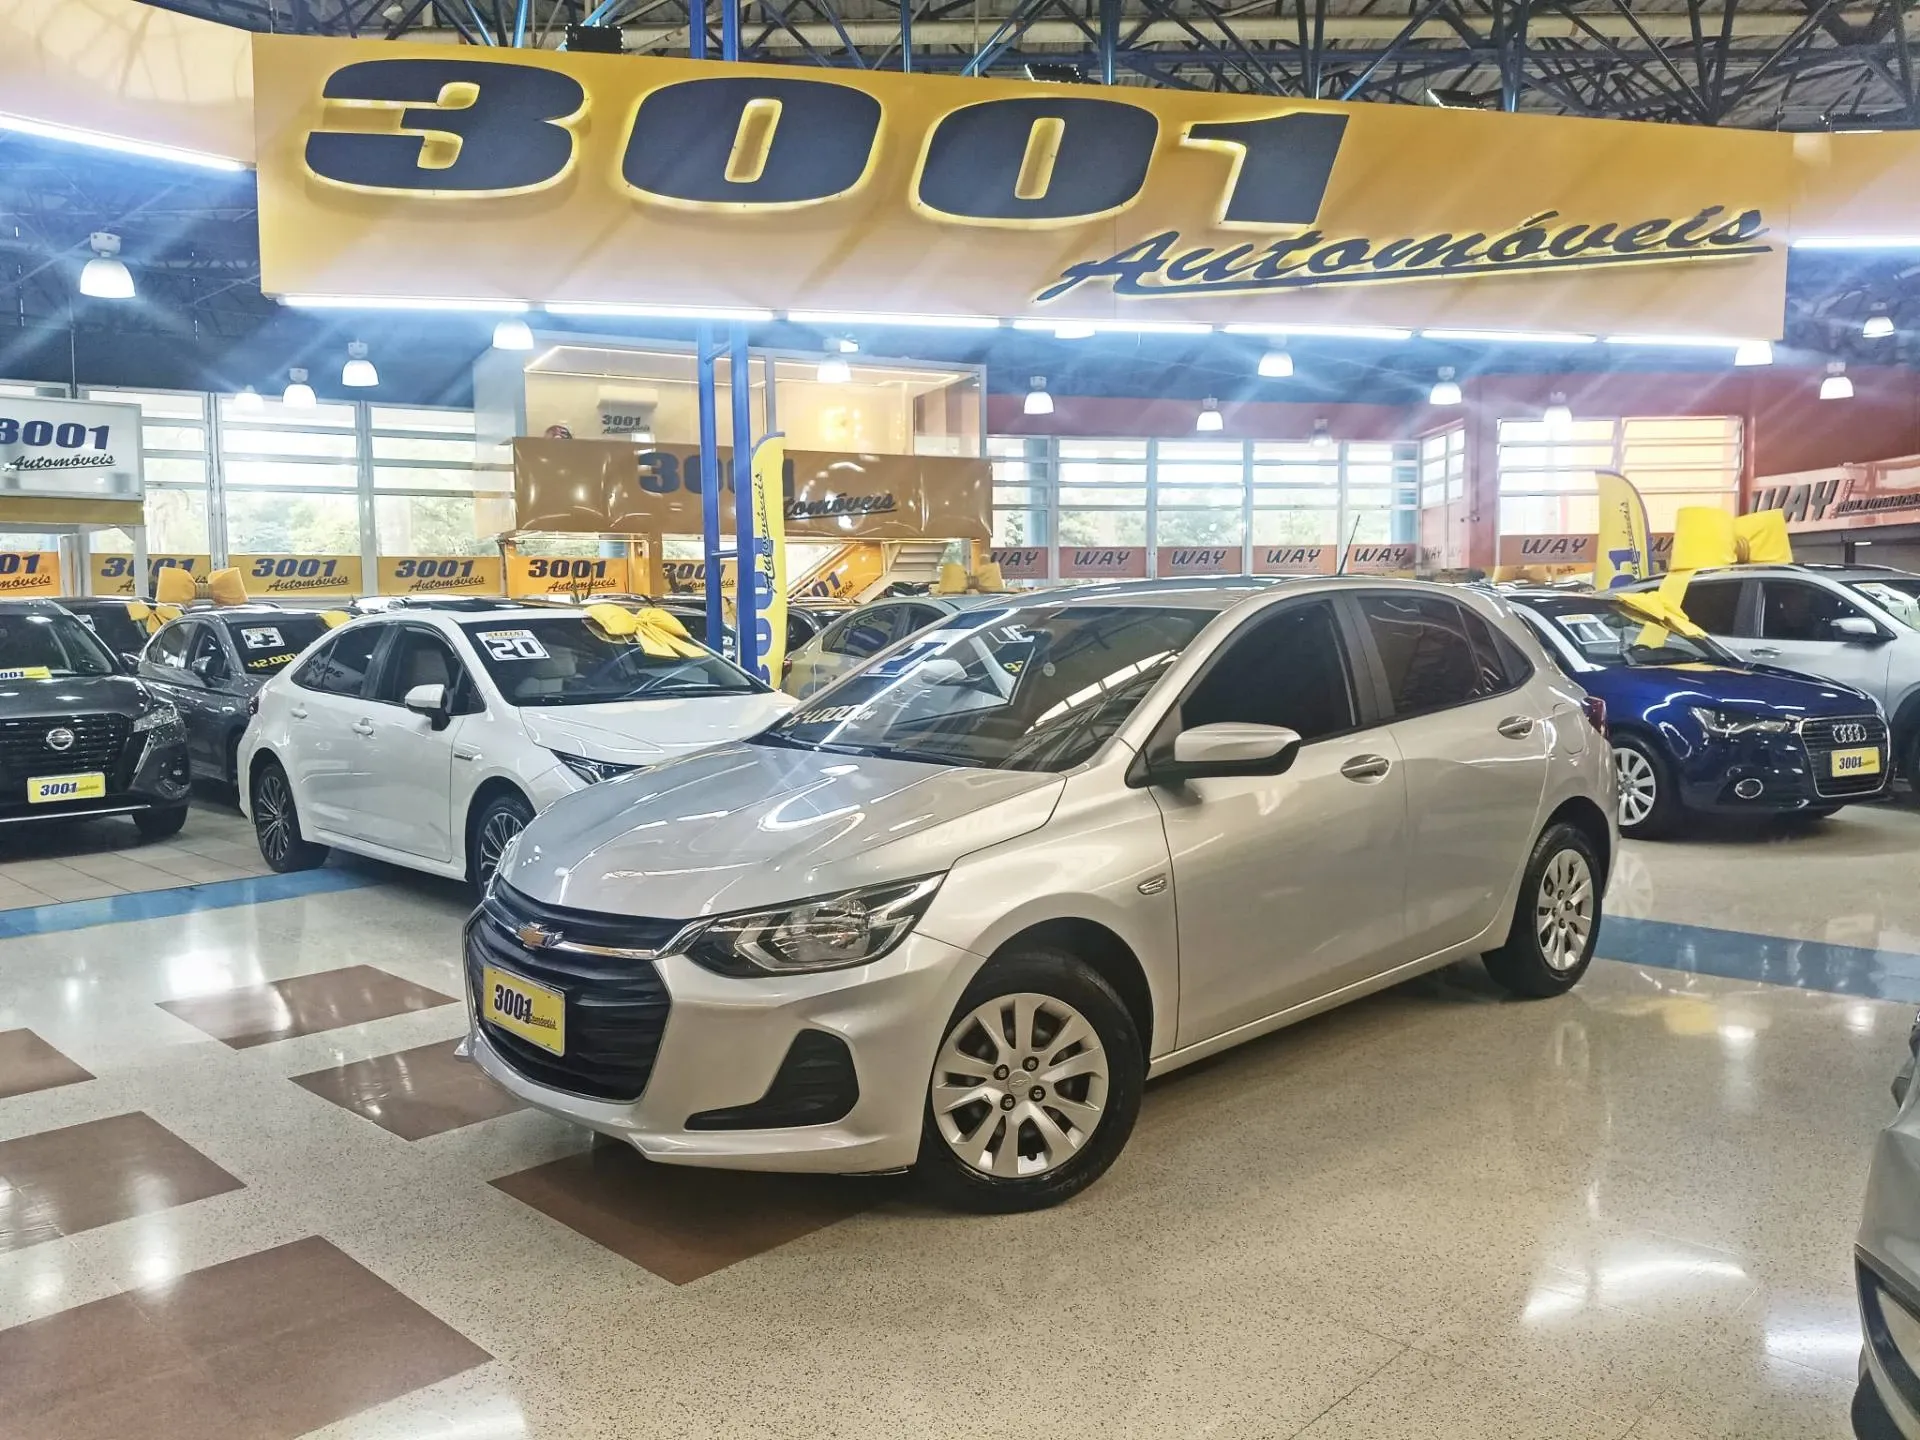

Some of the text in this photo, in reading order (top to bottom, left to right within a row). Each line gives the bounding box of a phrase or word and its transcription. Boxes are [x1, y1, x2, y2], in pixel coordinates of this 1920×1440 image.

[304, 57, 1348, 230] 3001
[1037, 205, 1773, 300] Automóveis
[602, 414, 641, 427] 3001
[6, 454, 117, 472] Automóveis
[1354, 547, 1408, 562] WAY
[1522, 538, 1588, 554] WAY
[1074, 550, 1131, 566] WAY
[1171, 550, 1227, 565] WAY
[1266, 548, 1321, 564] WAY
[251, 558, 338, 578] 3001
[395, 559, 475, 578] 3001
[528, 559, 608, 579] 3001
[267, 575, 351, 592] Automóveis
[409, 575, 486, 592] Automóveis
[489, 639, 547, 658] 20
[1839, 755, 1862, 769] 3001
[40, 783, 77, 796] 3001
[494, 984, 532, 1024] 3001
